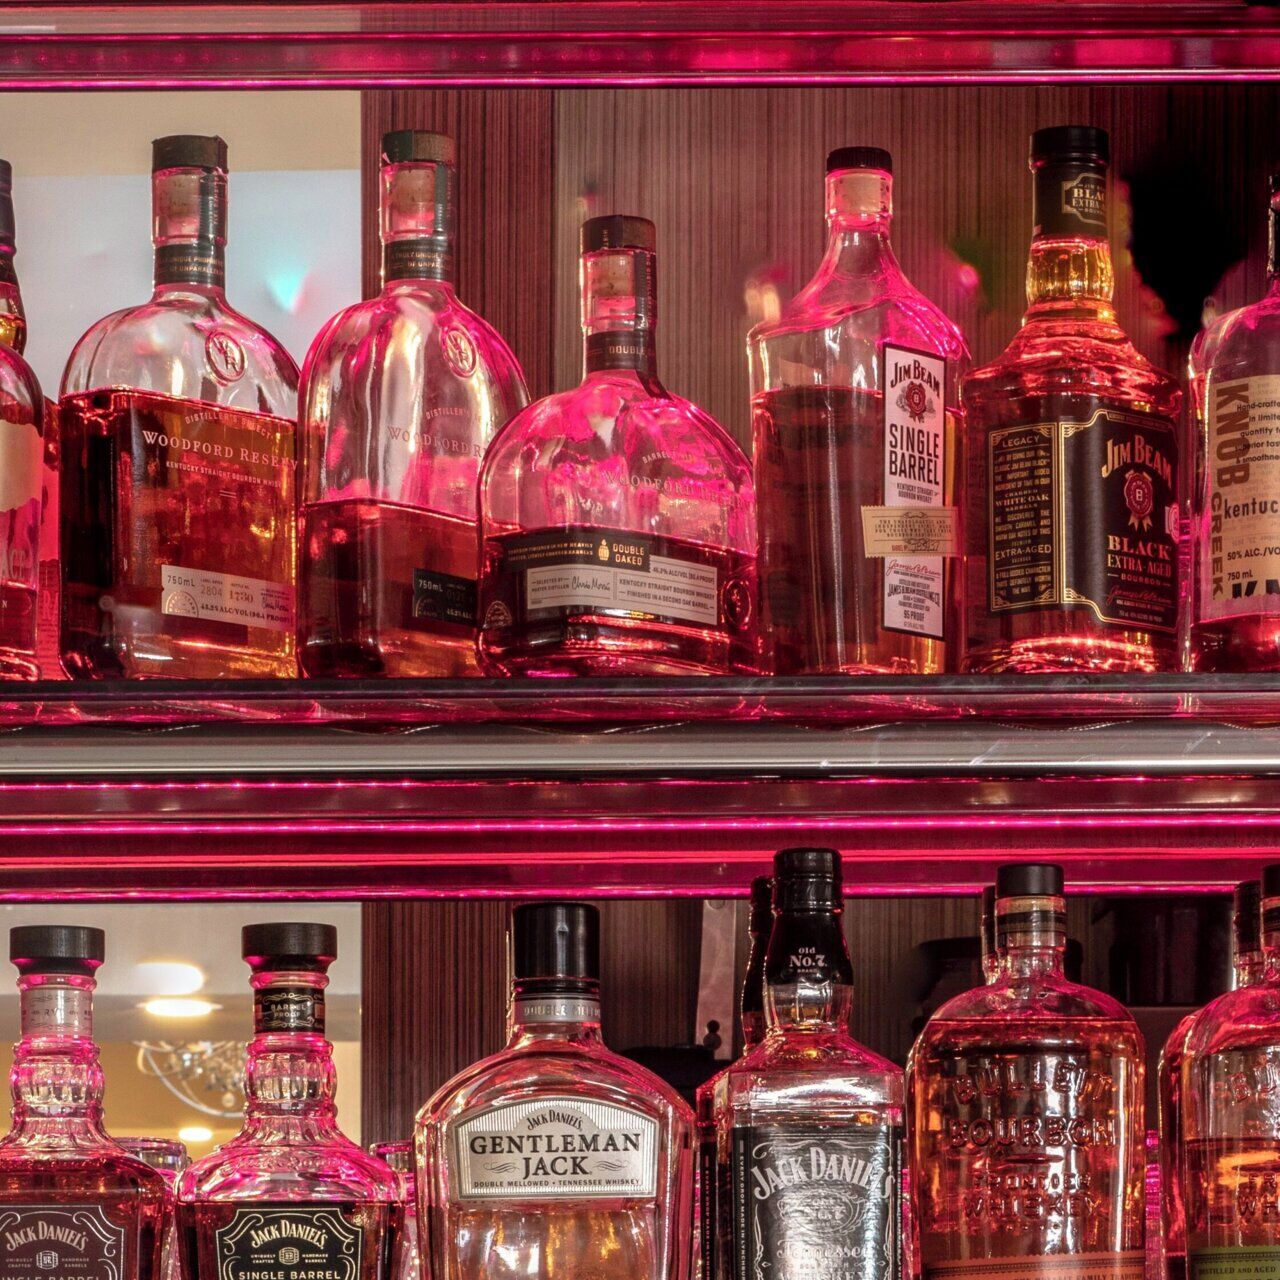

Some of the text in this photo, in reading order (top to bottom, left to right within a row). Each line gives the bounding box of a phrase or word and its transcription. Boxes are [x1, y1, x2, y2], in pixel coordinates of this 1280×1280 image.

[890, 359, 940, 398] JIM BEAM
[142, 430, 234, 459] WOODFORD
[889, 423, 939, 455] SINGLE
[889, 451, 940, 486] BARREL
[1101, 439, 1131, 478] JIM
[1135, 434, 1172, 490] BEAM
[612, 543, 644, 556] DOUBLE
[615, 554, 643, 565] OAKED
[1107, 535, 1170, 561] BLACK
[1107, 554, 1171, 577] EXTRA-AGED
[527, 1109, 583, 1132] JACK DANIEL'S
[470, 1132, 641, 1156] GENTLEMAN
[522, 1156, 589, 1178] JACK
[750, 1159, 804, 1201] JACK
[474, 1177, 641, 1188] DOUBLE MELLOWED TENNESSEE WHISKEY
[6, 1221, 89, 1251] JACK DANIEL'S
[250, 1220, 328, 1250] JACK DANIEL'S
[239, 1271, 341, 1280] SINGLE BARREL
